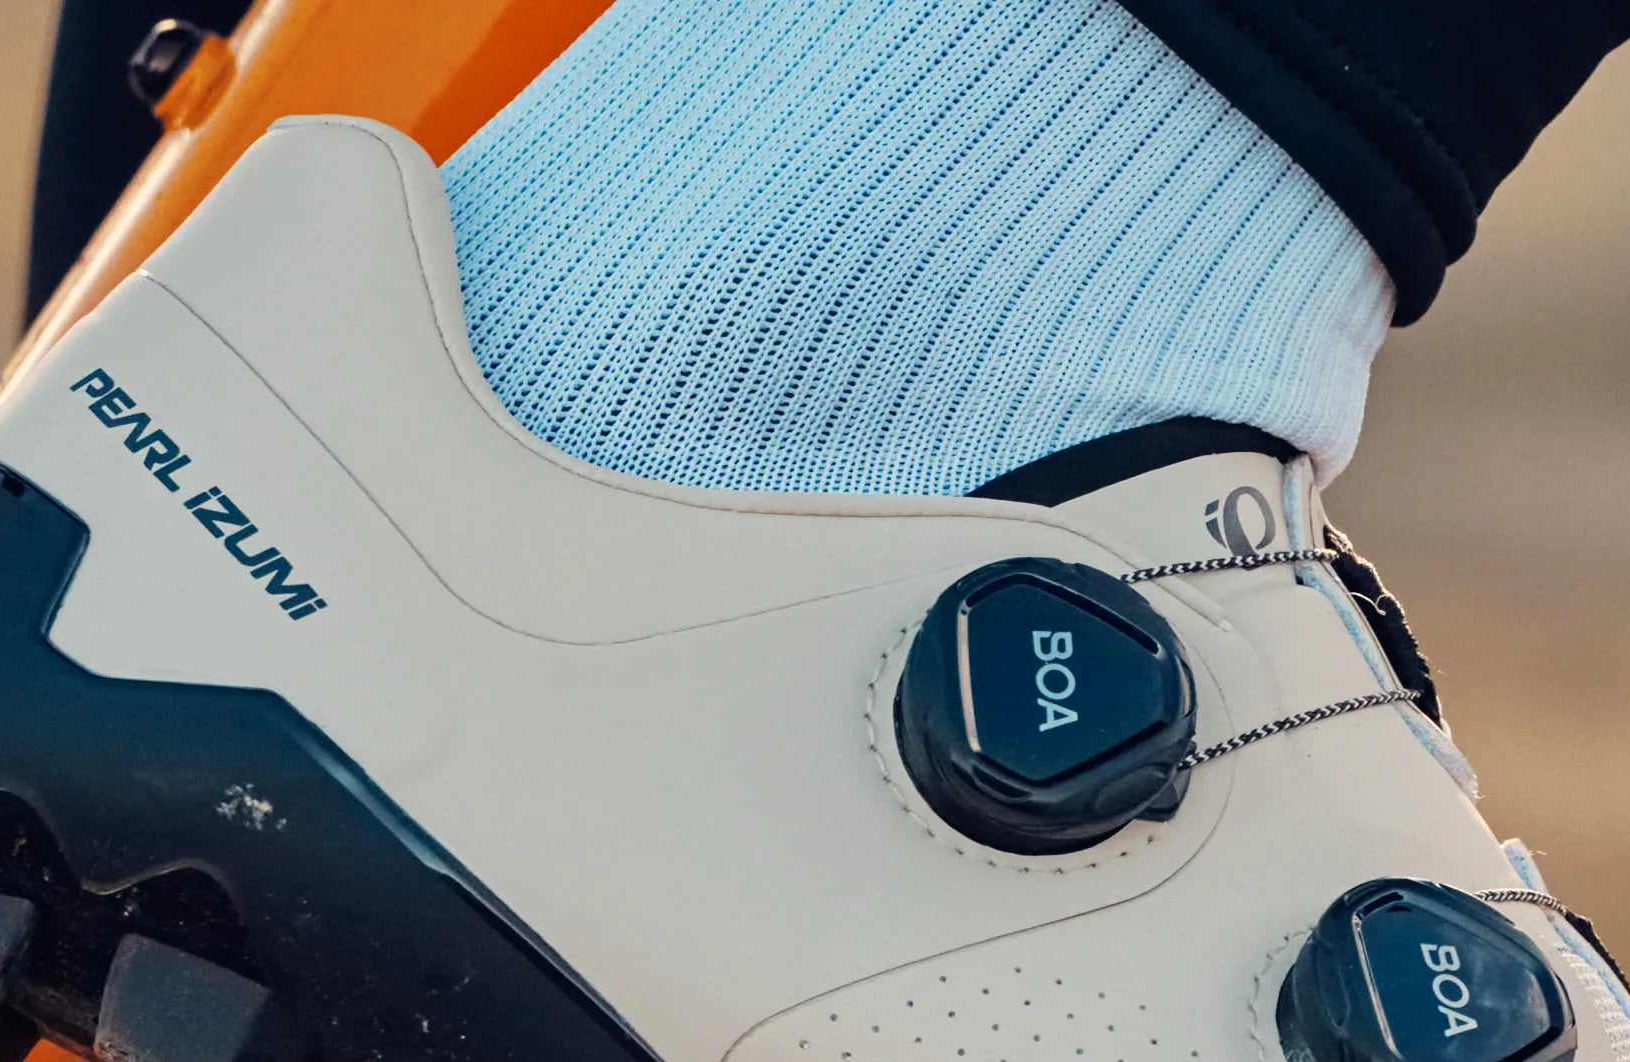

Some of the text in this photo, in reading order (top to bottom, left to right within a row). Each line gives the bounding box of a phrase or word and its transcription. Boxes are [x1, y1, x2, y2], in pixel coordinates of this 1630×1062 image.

[69, 368, 191, 493] PEARL
[1032, 630, 1079, 732] BOA
[1420, 943, 1478, 1038] BOA
